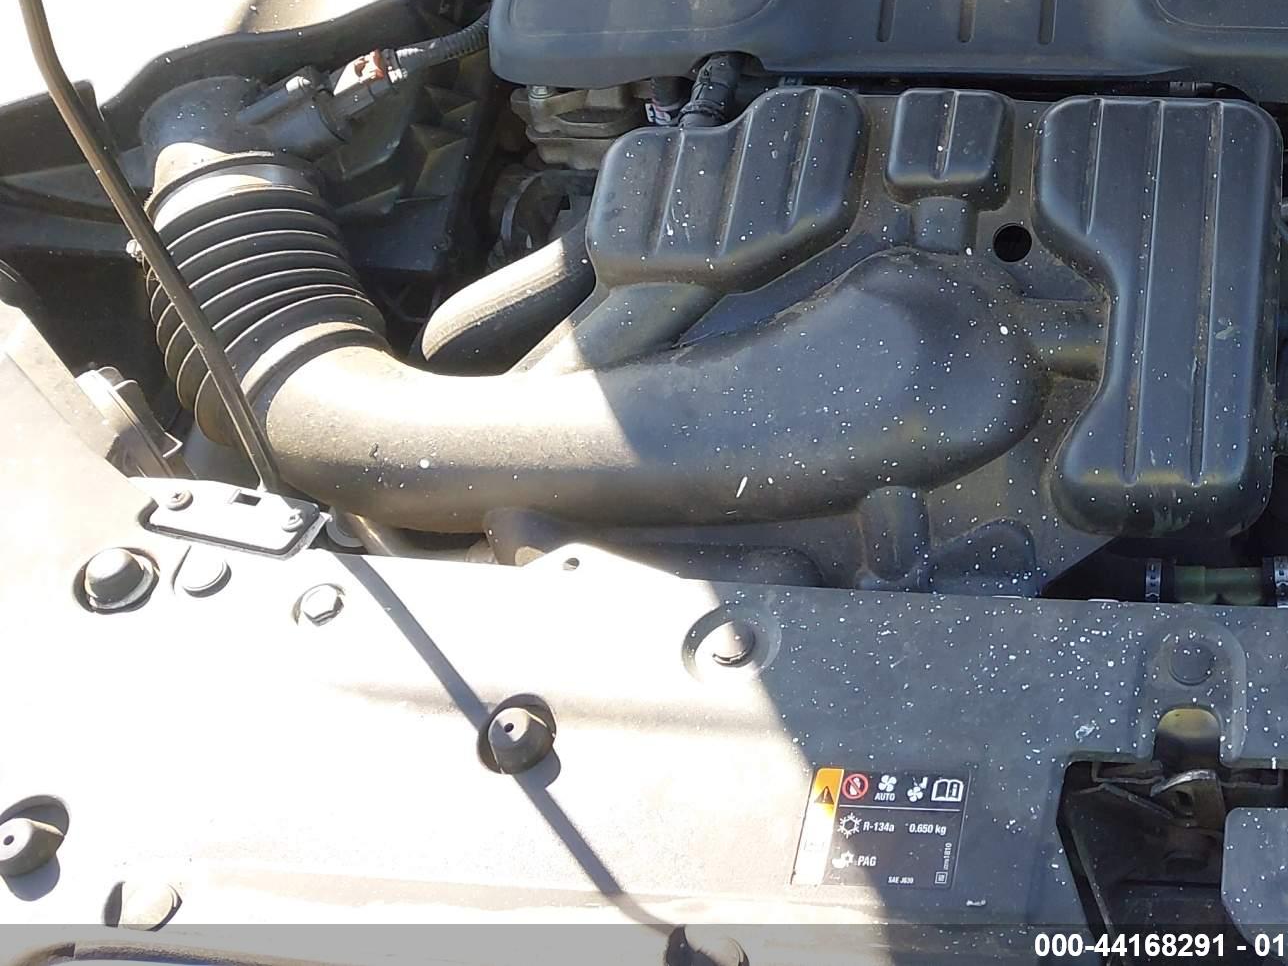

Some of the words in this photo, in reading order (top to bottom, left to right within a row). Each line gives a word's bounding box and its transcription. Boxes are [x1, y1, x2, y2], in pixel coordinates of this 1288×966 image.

[875, 793, 895, 801] AUTO
[863, 819, 895, 833] R-134a
[909, 823, 934, 834] 0.650
[935, 824, 947, 835] kg
[857, 855, 876, 867] PAG
